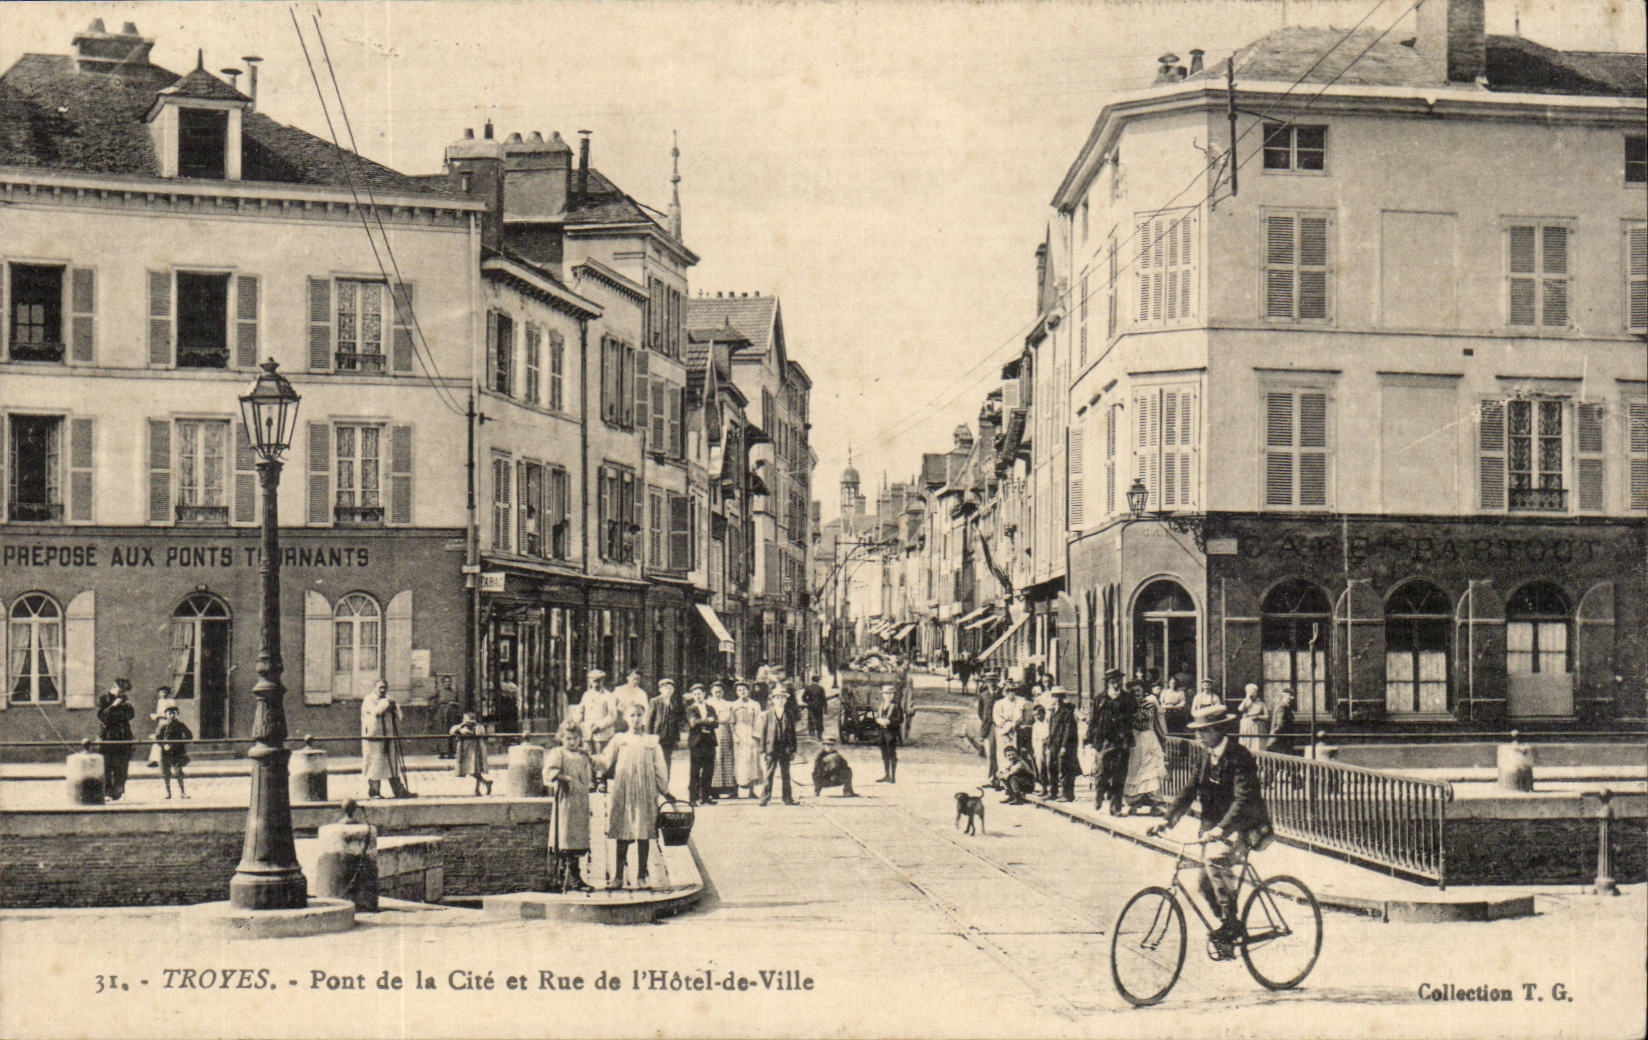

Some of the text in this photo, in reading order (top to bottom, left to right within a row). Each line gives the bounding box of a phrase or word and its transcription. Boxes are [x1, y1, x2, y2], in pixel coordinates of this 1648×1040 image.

[3, 542, 369, 567] PRÉPOSÉ AUX PONTS TRNANTS
